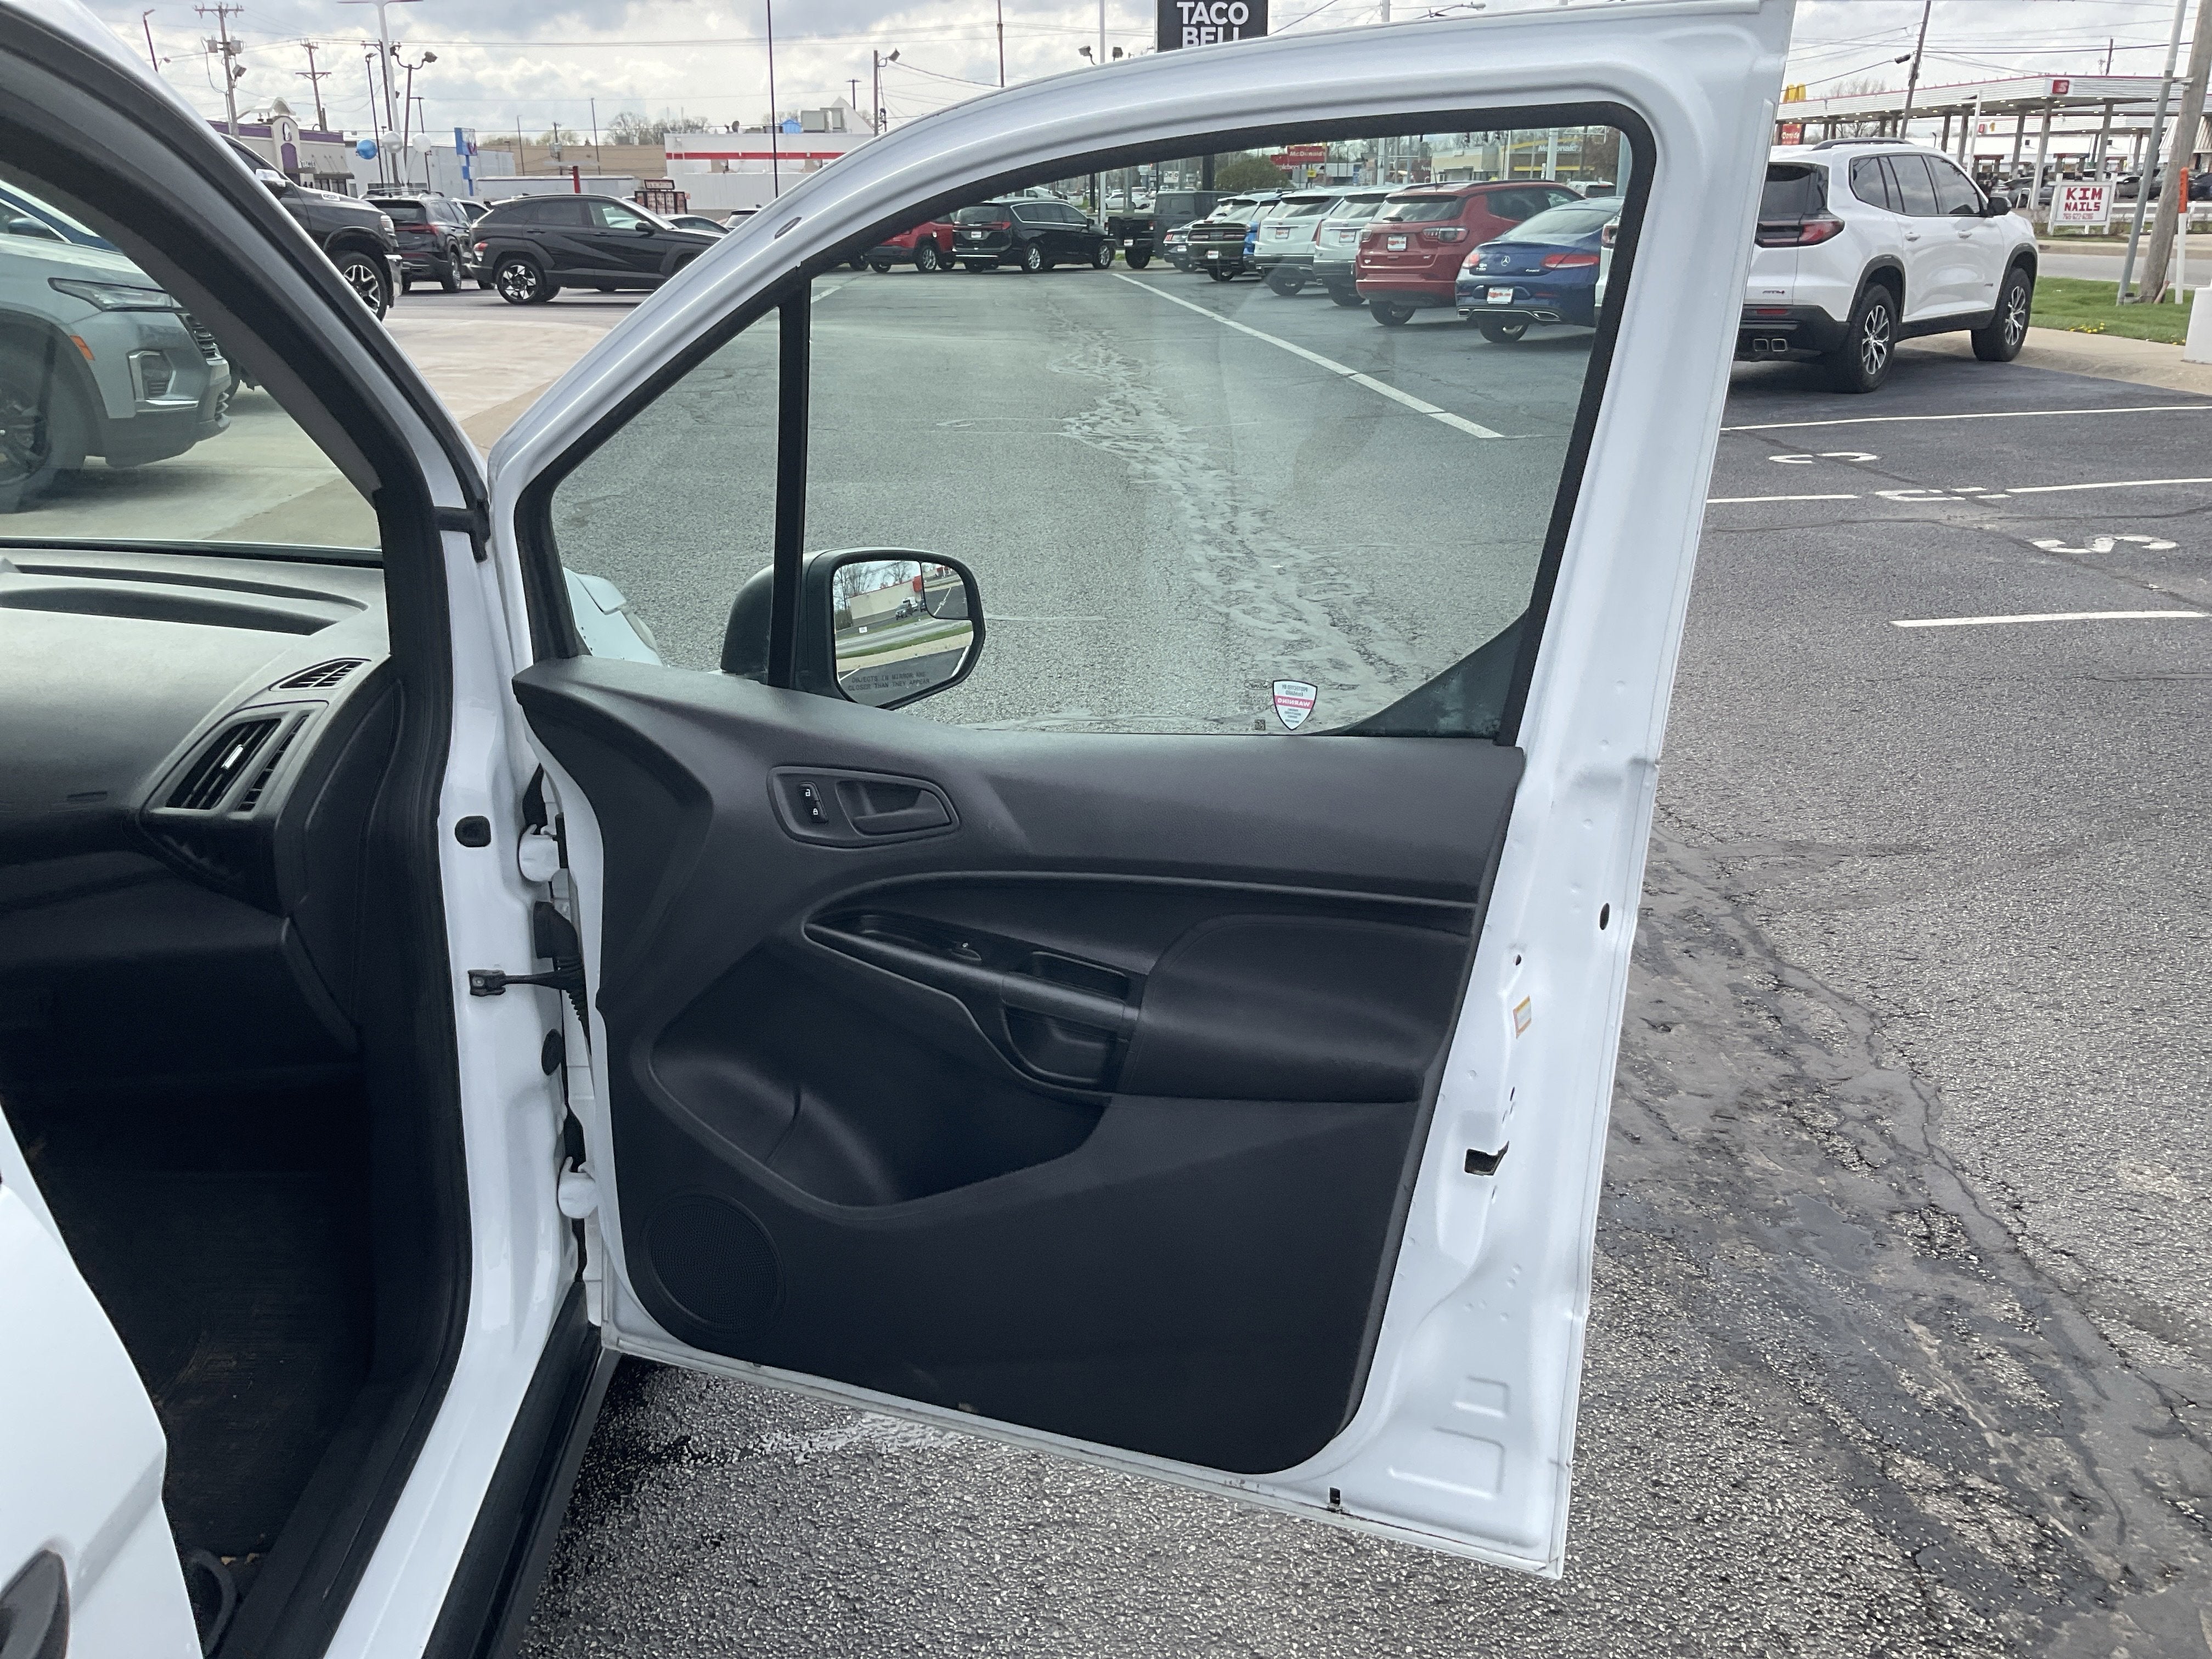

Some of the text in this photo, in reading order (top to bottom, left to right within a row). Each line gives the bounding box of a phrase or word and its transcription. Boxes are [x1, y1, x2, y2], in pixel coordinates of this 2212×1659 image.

[1177, 2, 1249, 25] TACO
[2066, 188, 2103, 200] KIM
[2064, 202, 2101, 211] NAILS
